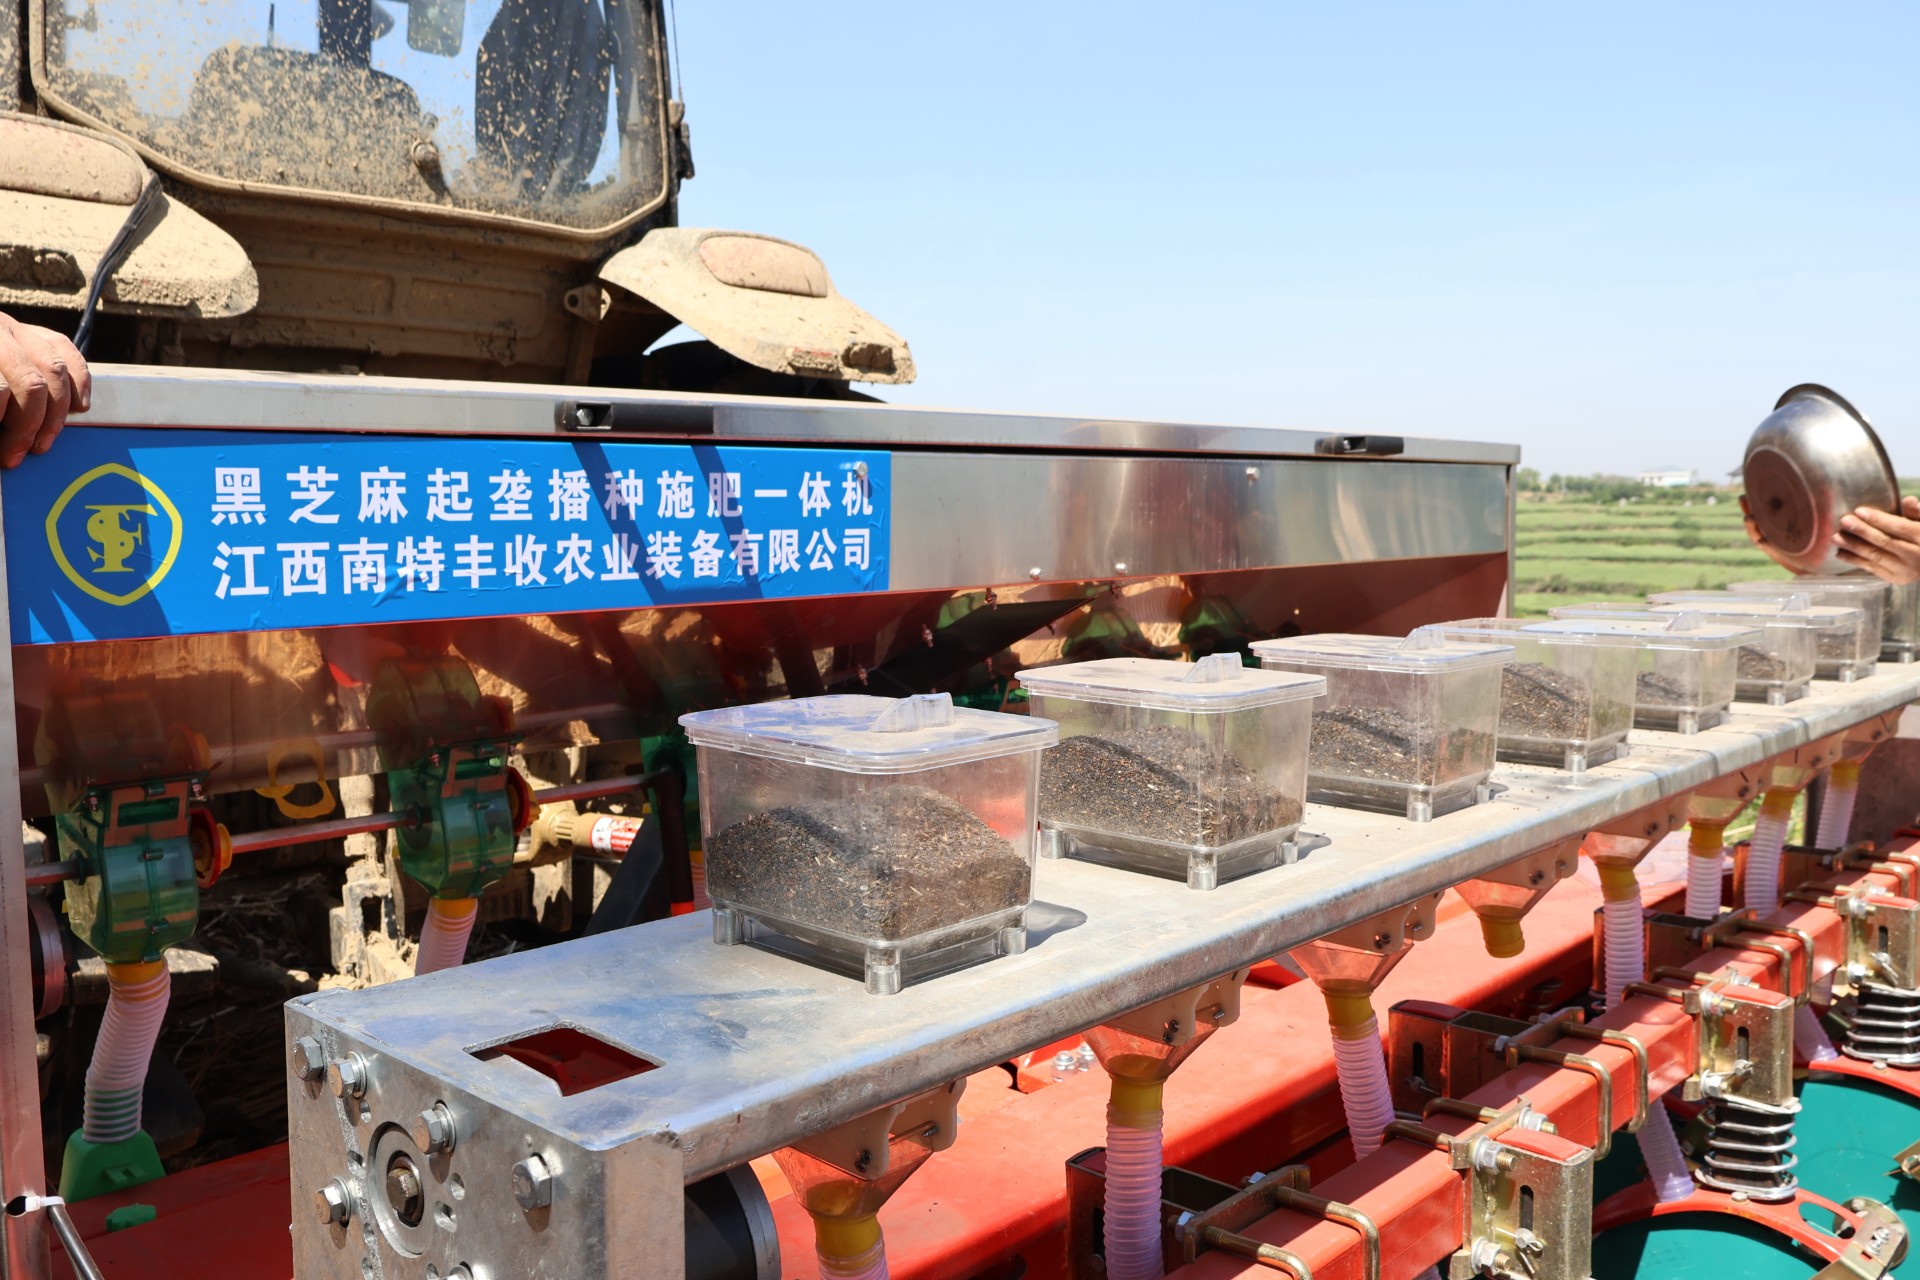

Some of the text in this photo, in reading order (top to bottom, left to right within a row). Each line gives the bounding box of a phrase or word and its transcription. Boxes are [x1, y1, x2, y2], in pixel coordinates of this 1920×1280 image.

[211, 465, 873, 526] 黑芝麻起垄播种施肥一体机
[212, 528, 871, 599] 江西南特丰收农业装备有限公司
